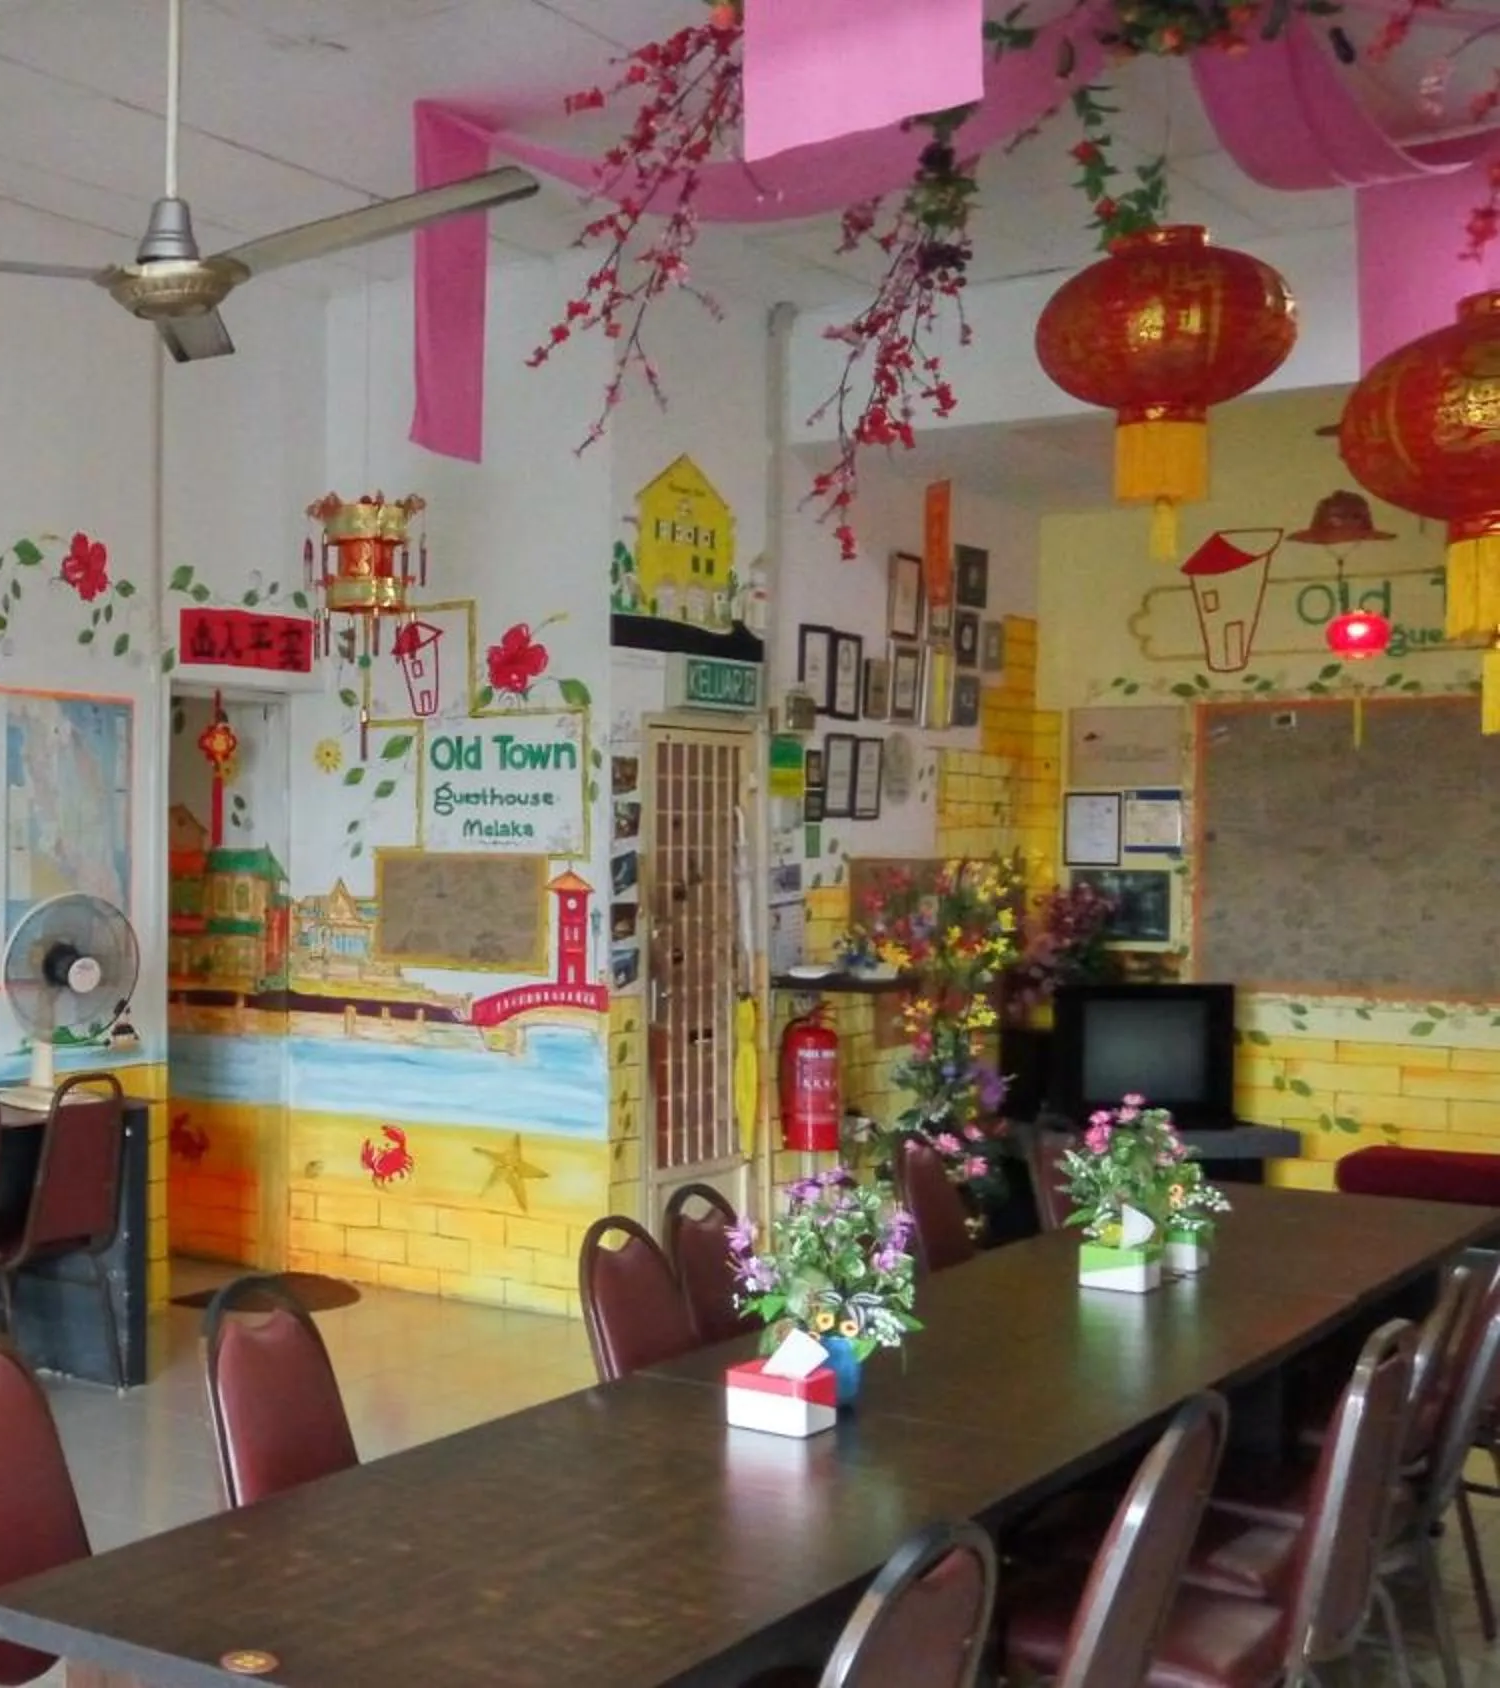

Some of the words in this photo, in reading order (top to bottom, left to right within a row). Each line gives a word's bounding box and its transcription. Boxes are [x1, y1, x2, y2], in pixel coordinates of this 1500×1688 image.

[429, 735, 483, 771] Old
[491, 734, 577, 771] Town
[462, 818, 535, 838] Melaka
